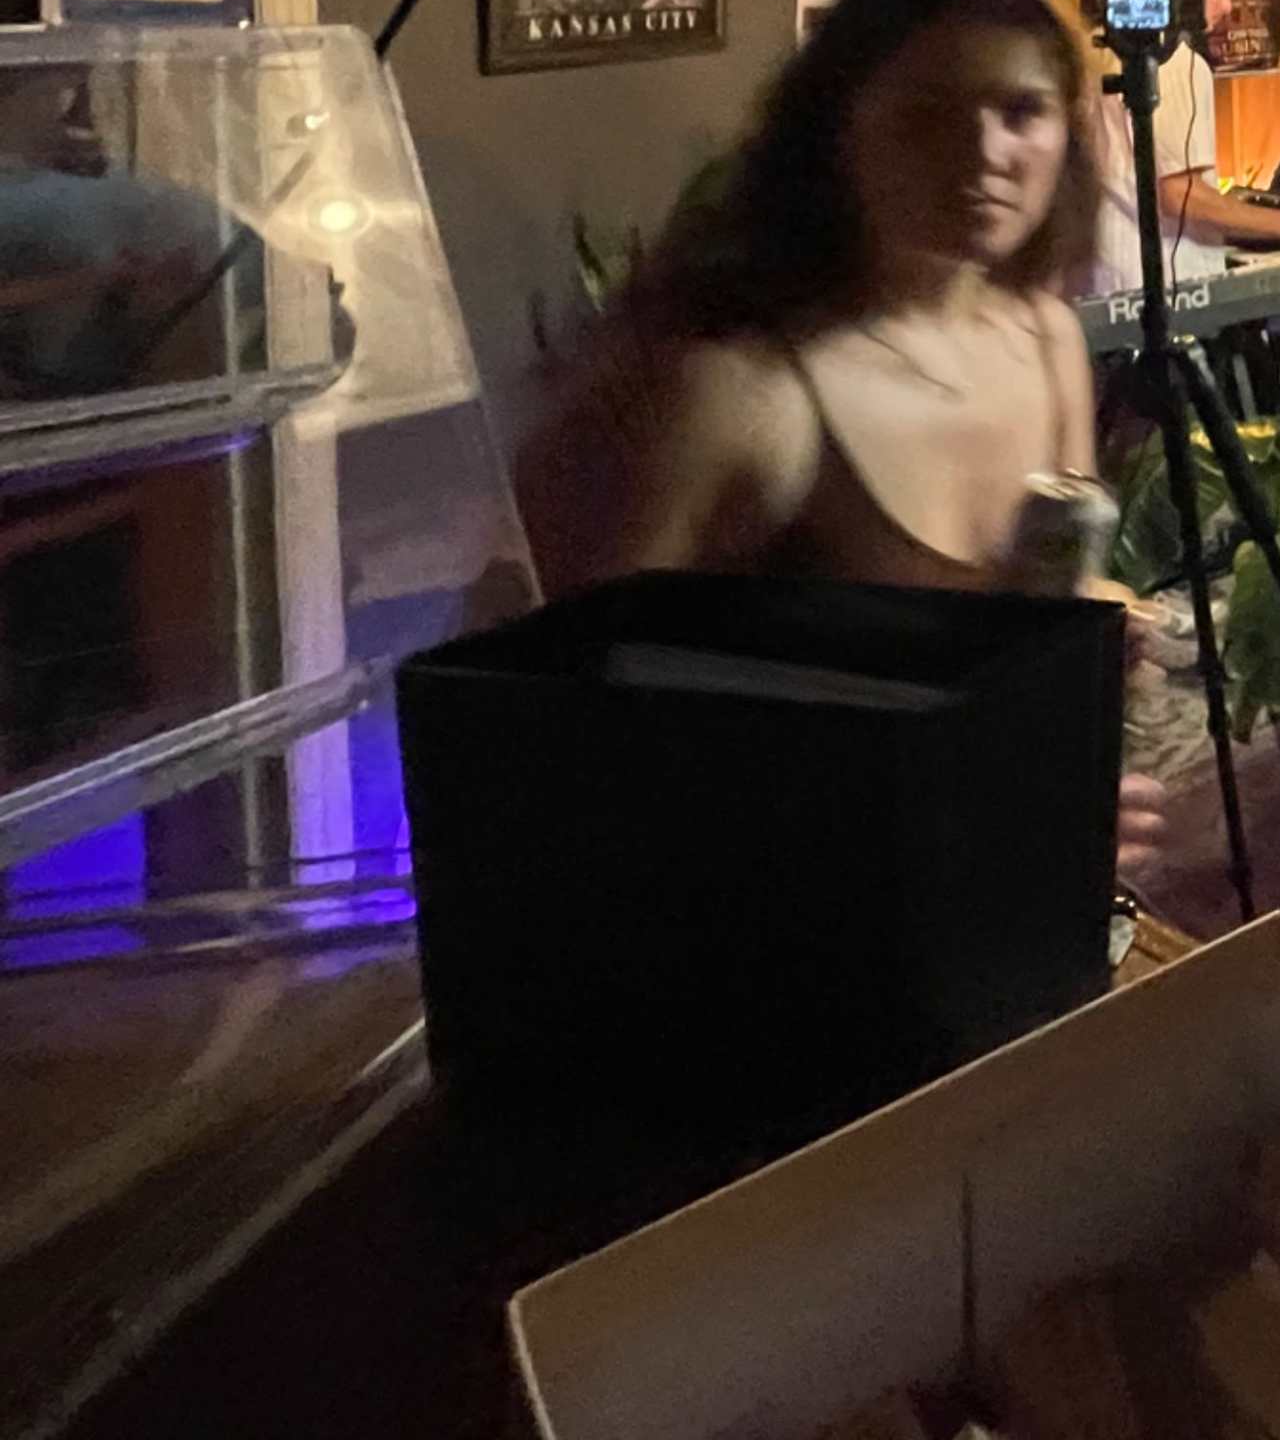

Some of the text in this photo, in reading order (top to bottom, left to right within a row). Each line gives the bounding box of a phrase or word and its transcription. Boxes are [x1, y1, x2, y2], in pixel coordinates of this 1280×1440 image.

[528, 10, 696, 41] KANSAS CITY
[1108, 282, 1211, 325] Rond
